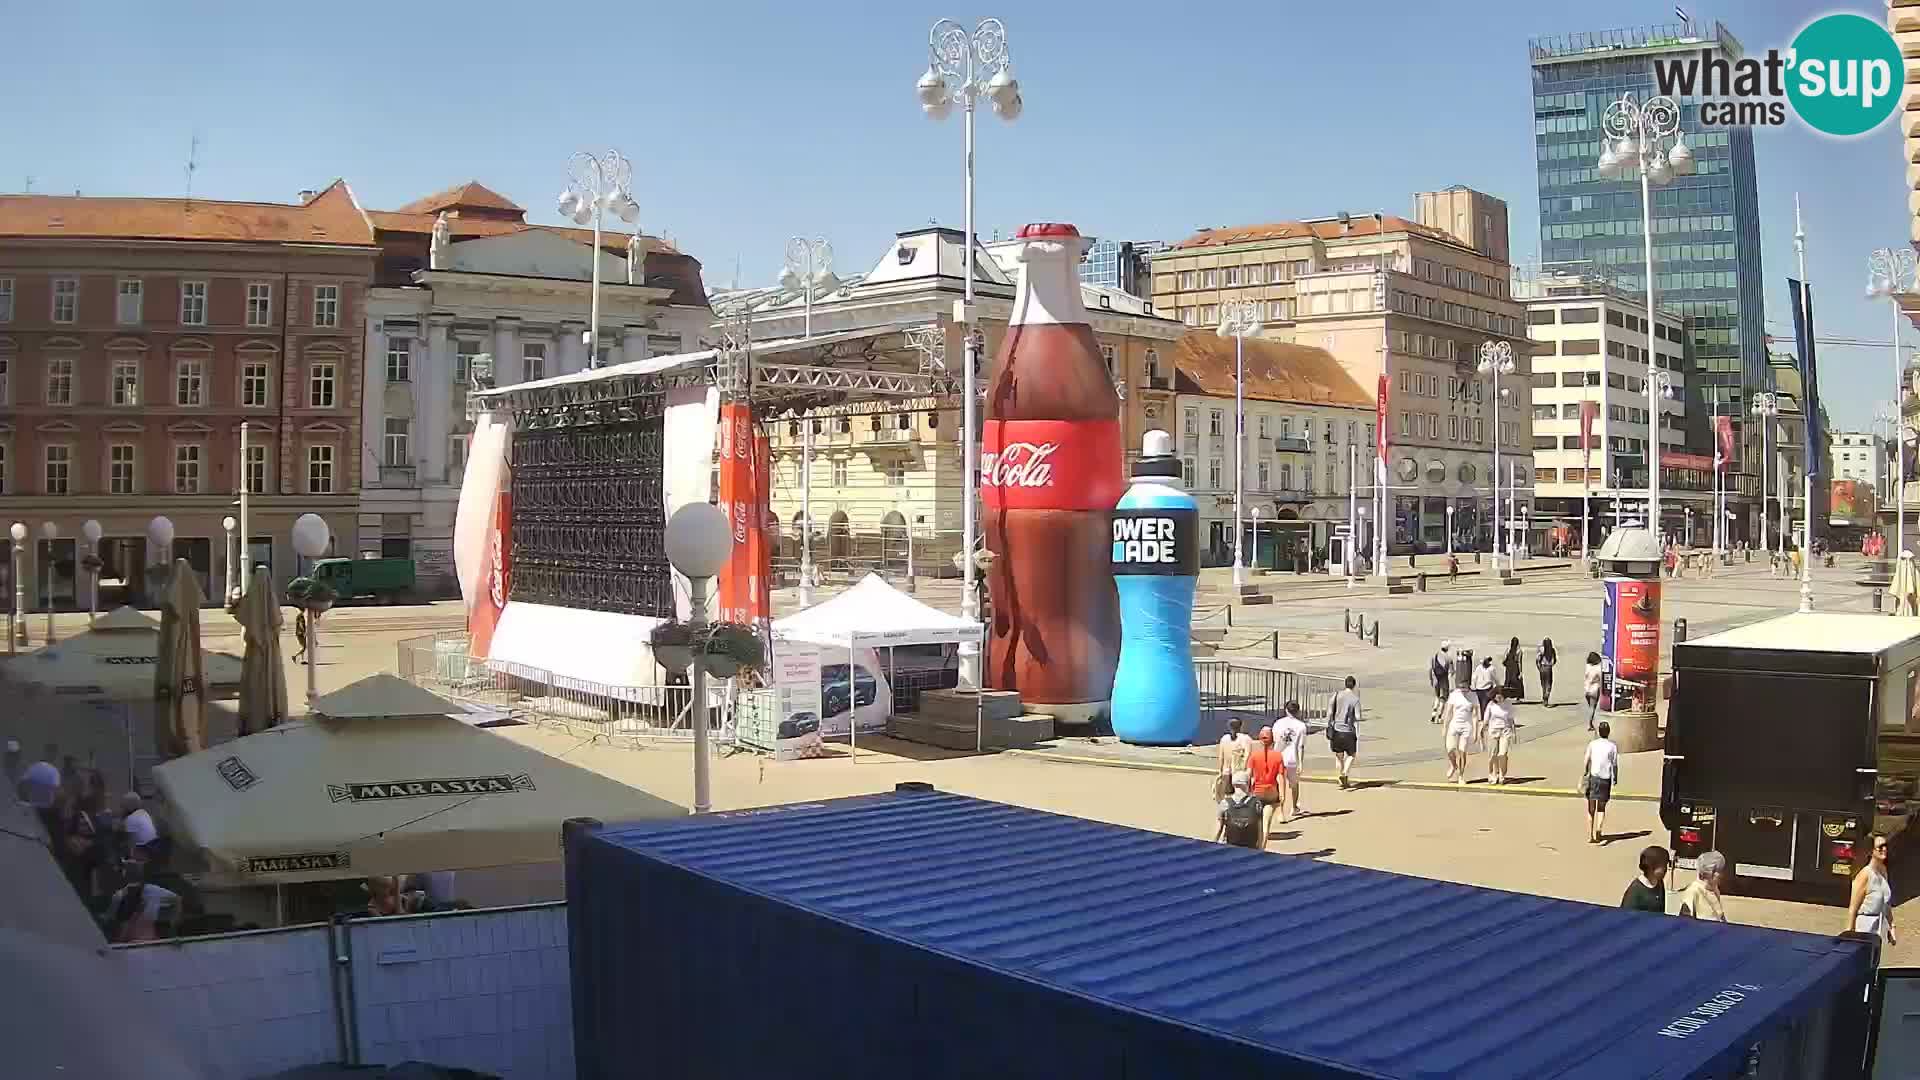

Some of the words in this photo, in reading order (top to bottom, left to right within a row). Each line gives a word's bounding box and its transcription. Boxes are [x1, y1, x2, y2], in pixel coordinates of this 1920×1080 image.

[1125, 541, 1176, 564] ADE
[359, 777, 508, 798] MARASKA
[253, 856, 335, 872] MARASKA
[1691, 990, 1746, 1018] 300629
